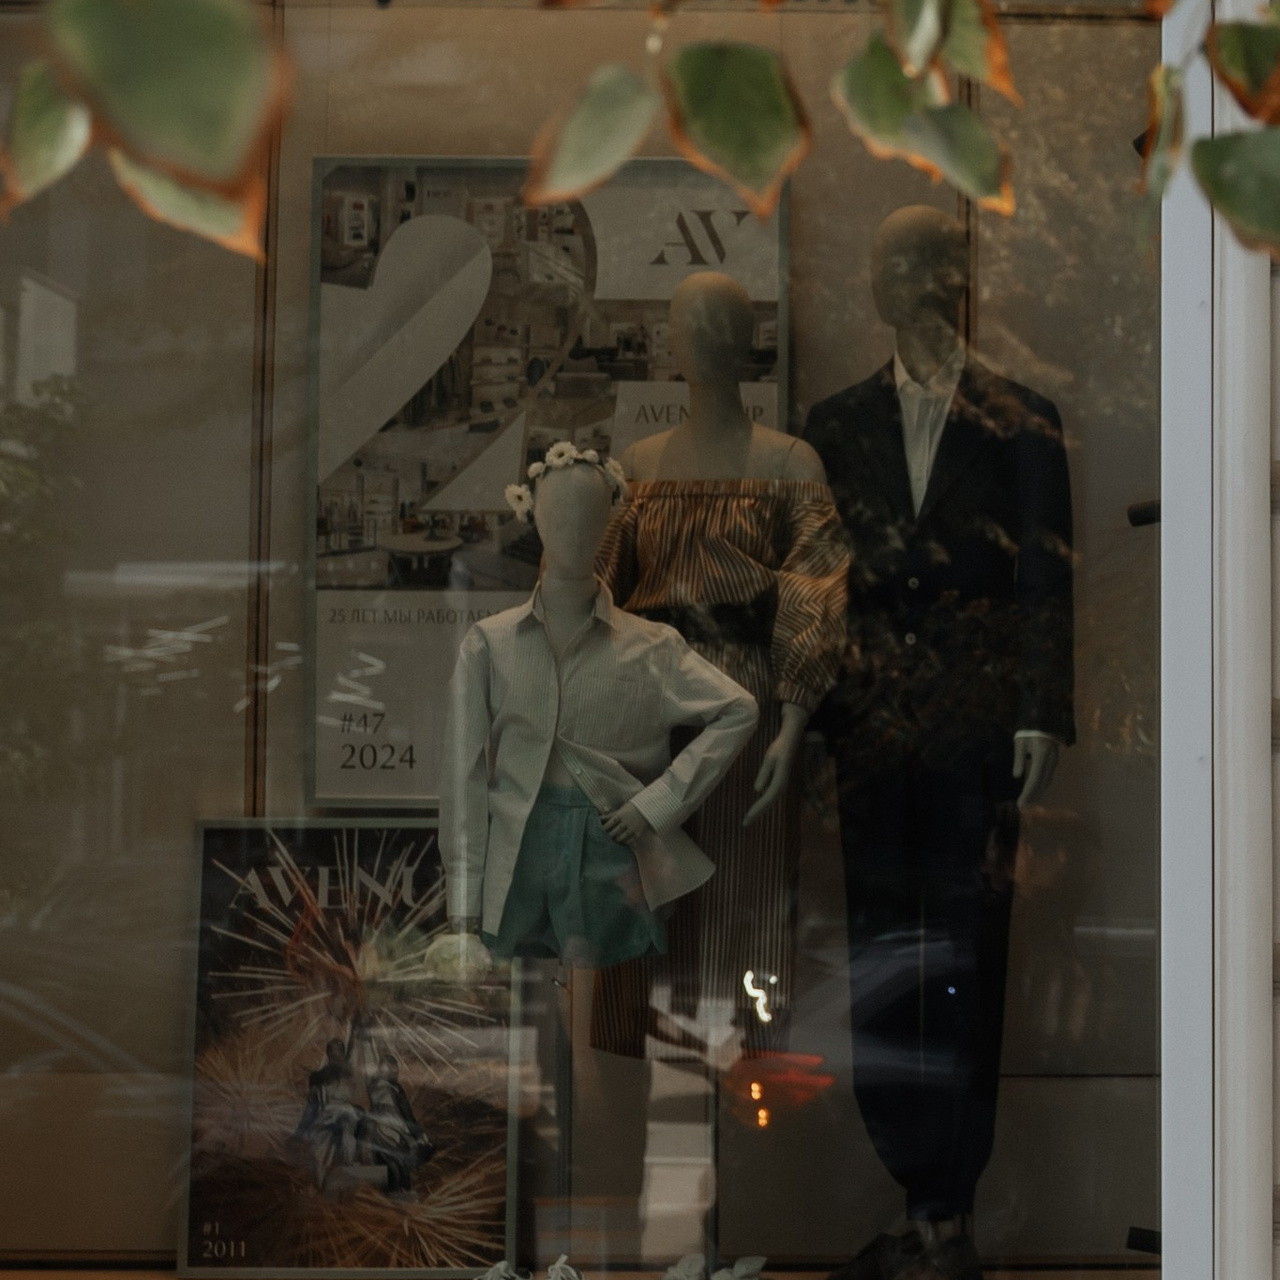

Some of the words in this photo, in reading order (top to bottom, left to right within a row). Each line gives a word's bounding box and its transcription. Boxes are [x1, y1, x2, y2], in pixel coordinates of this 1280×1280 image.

[649, 209, 750, 265] AV
[634, 403, 691, 424] AVEN
[328, 607, 346, 624] 25
[350, 608, 379, 624] ЛЕТ
[383, 608, 412, 624] МЫ
[340, 711, 386, 734] #47
[339, 742, 418, 771] 2024
[227, 864, 446, 910] AVENU
[202, 1239, 247, 1259] 2011
